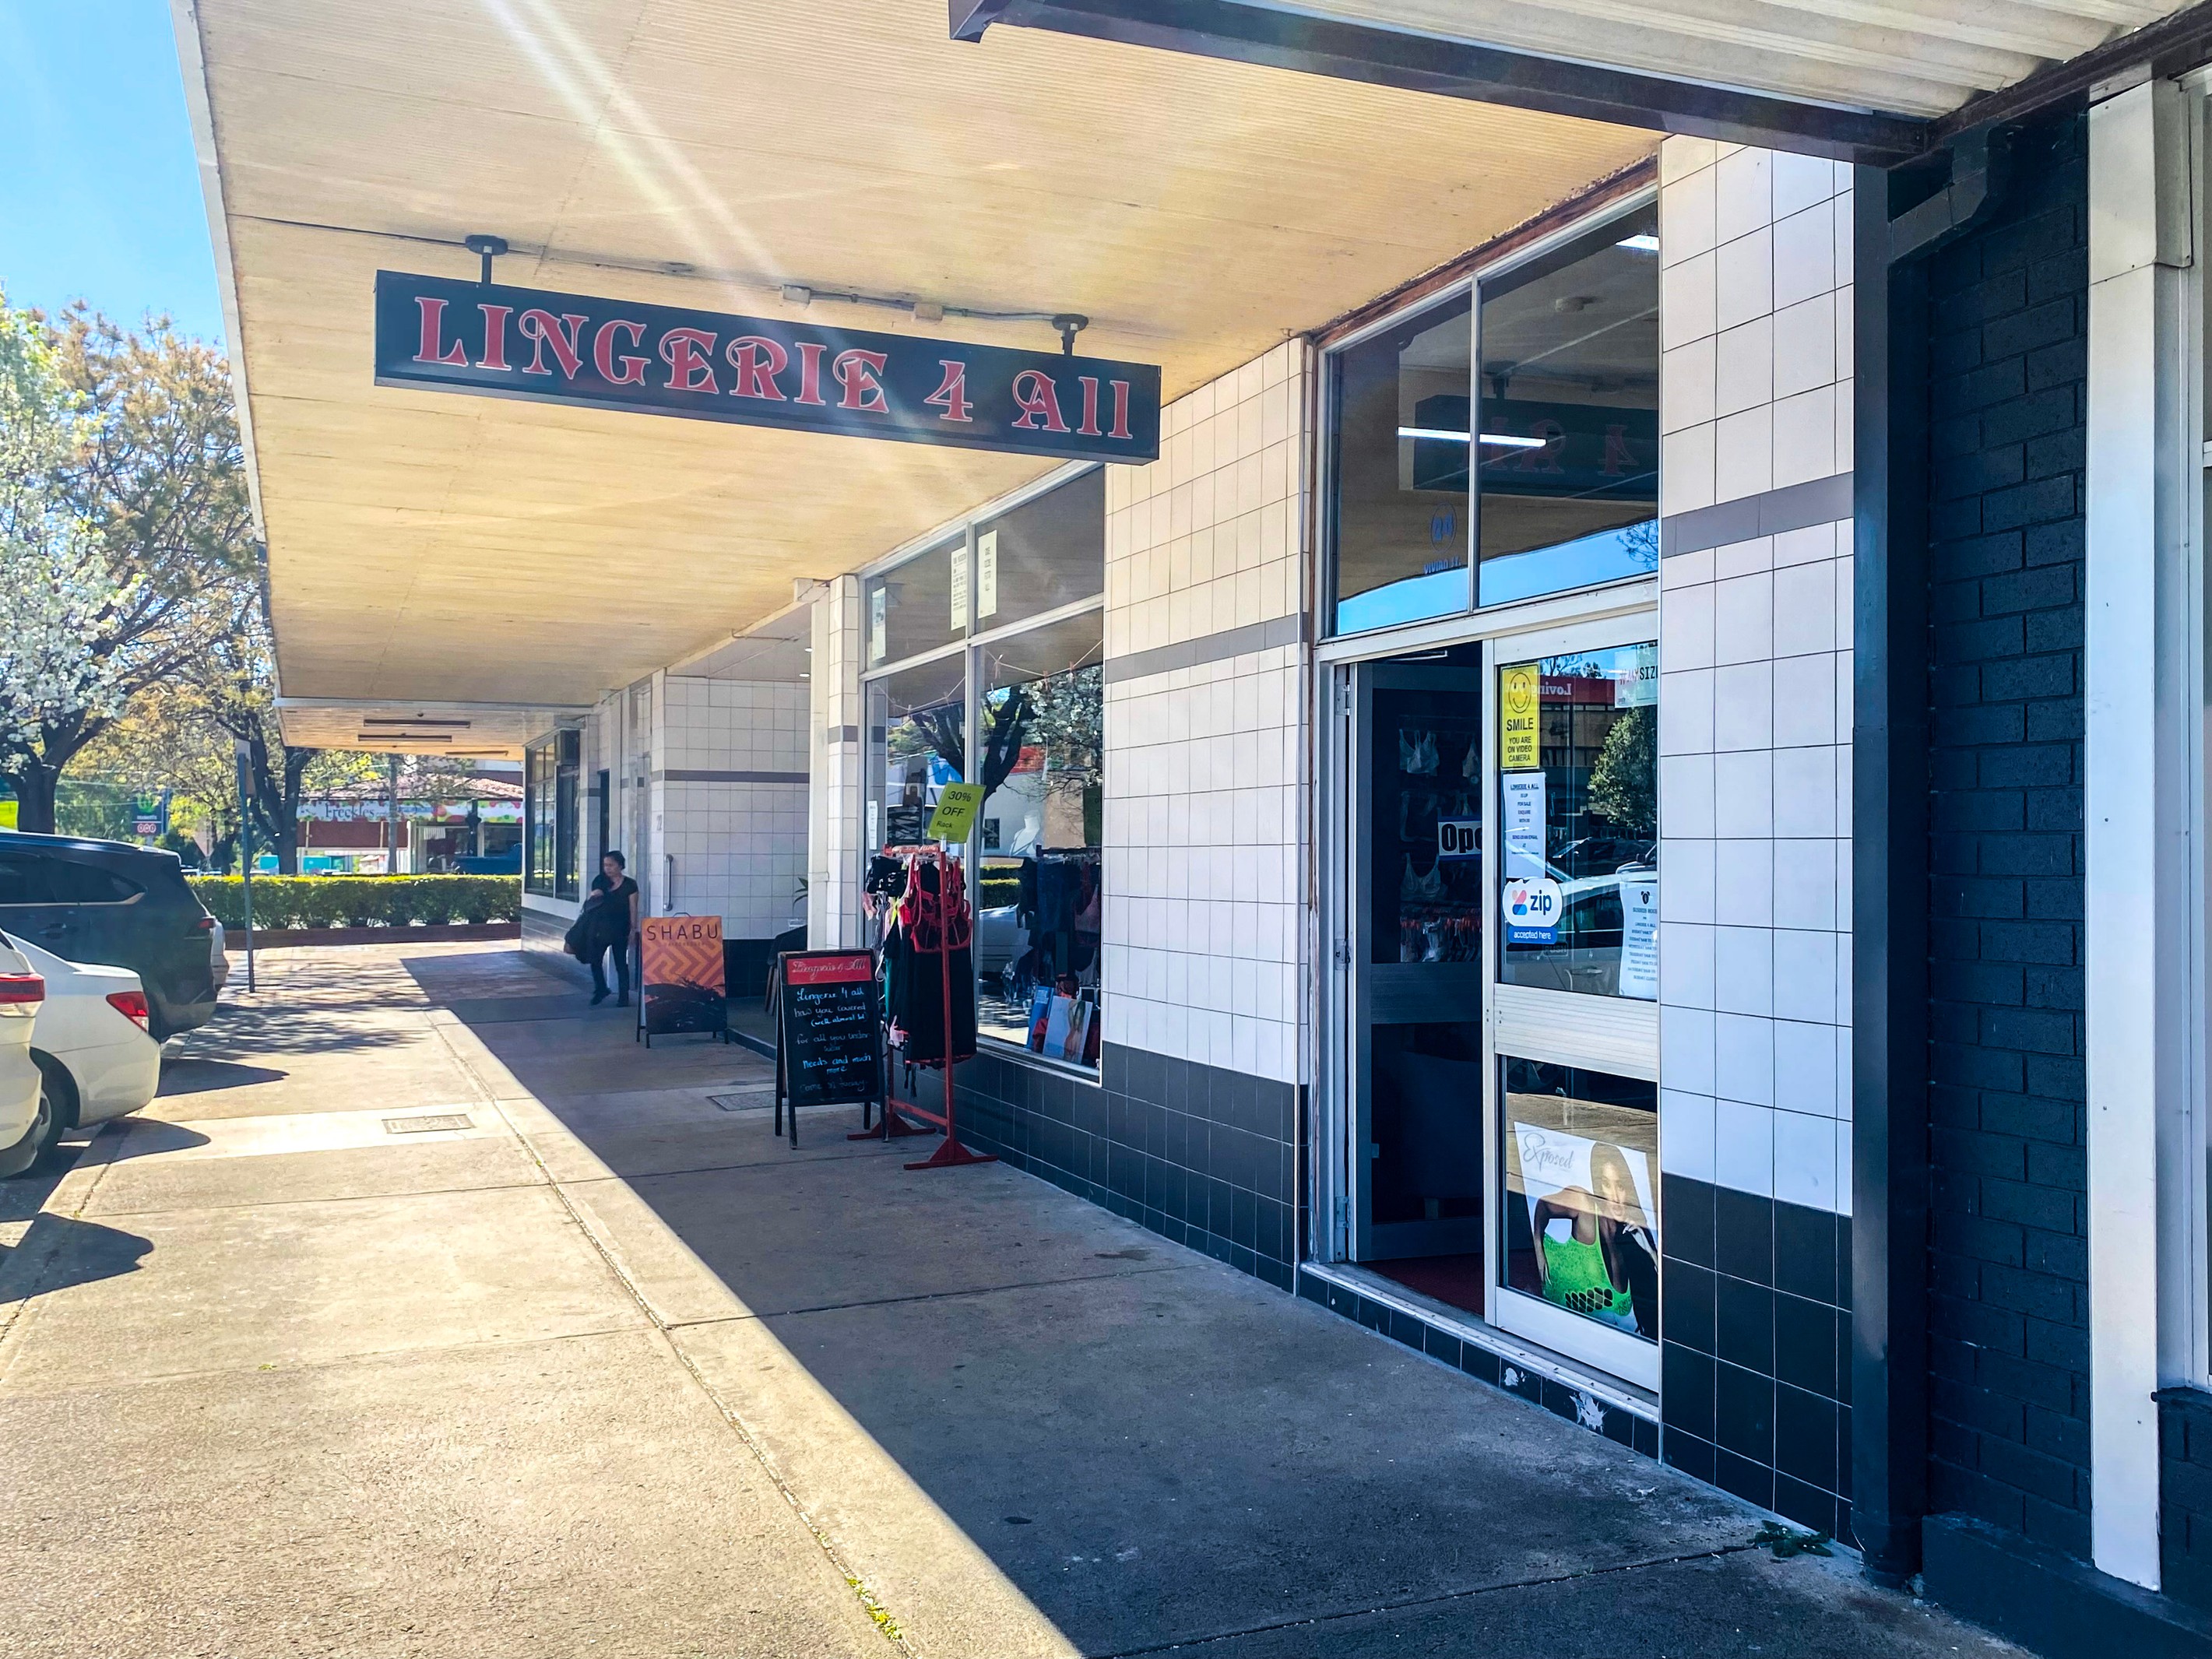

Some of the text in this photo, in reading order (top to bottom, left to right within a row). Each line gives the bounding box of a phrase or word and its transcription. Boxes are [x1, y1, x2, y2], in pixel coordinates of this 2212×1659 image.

[413, 296, 889, 414] LINGERIE
[923, 360, 973, 423] 4
[1507, 718, 1533, 731] SMILE
[948, 791, 972, 802] 30%
[942, 807, 965, 817] OFF
[1530, 889, 1553, 916] zip
[646, 923, 719, 940] SHABU
[1514, 930, 1552, 940] accepted here
[797, 988, 837, 1005] Lingerie
[815, 1007, 833, 1018] you
[837, 1002, 866, 1012] covered
[797, 1033, 809, 1045] for
[813, 1033, 827, 1042] all
[829, 1034, 846, 1046] you
[832, 1055, 848, 1065] and
[852, 1053, 871, 1063] much
[826, 1066, 847, 1074] more
[1523, 1132, 1575, 1172] Exposed
